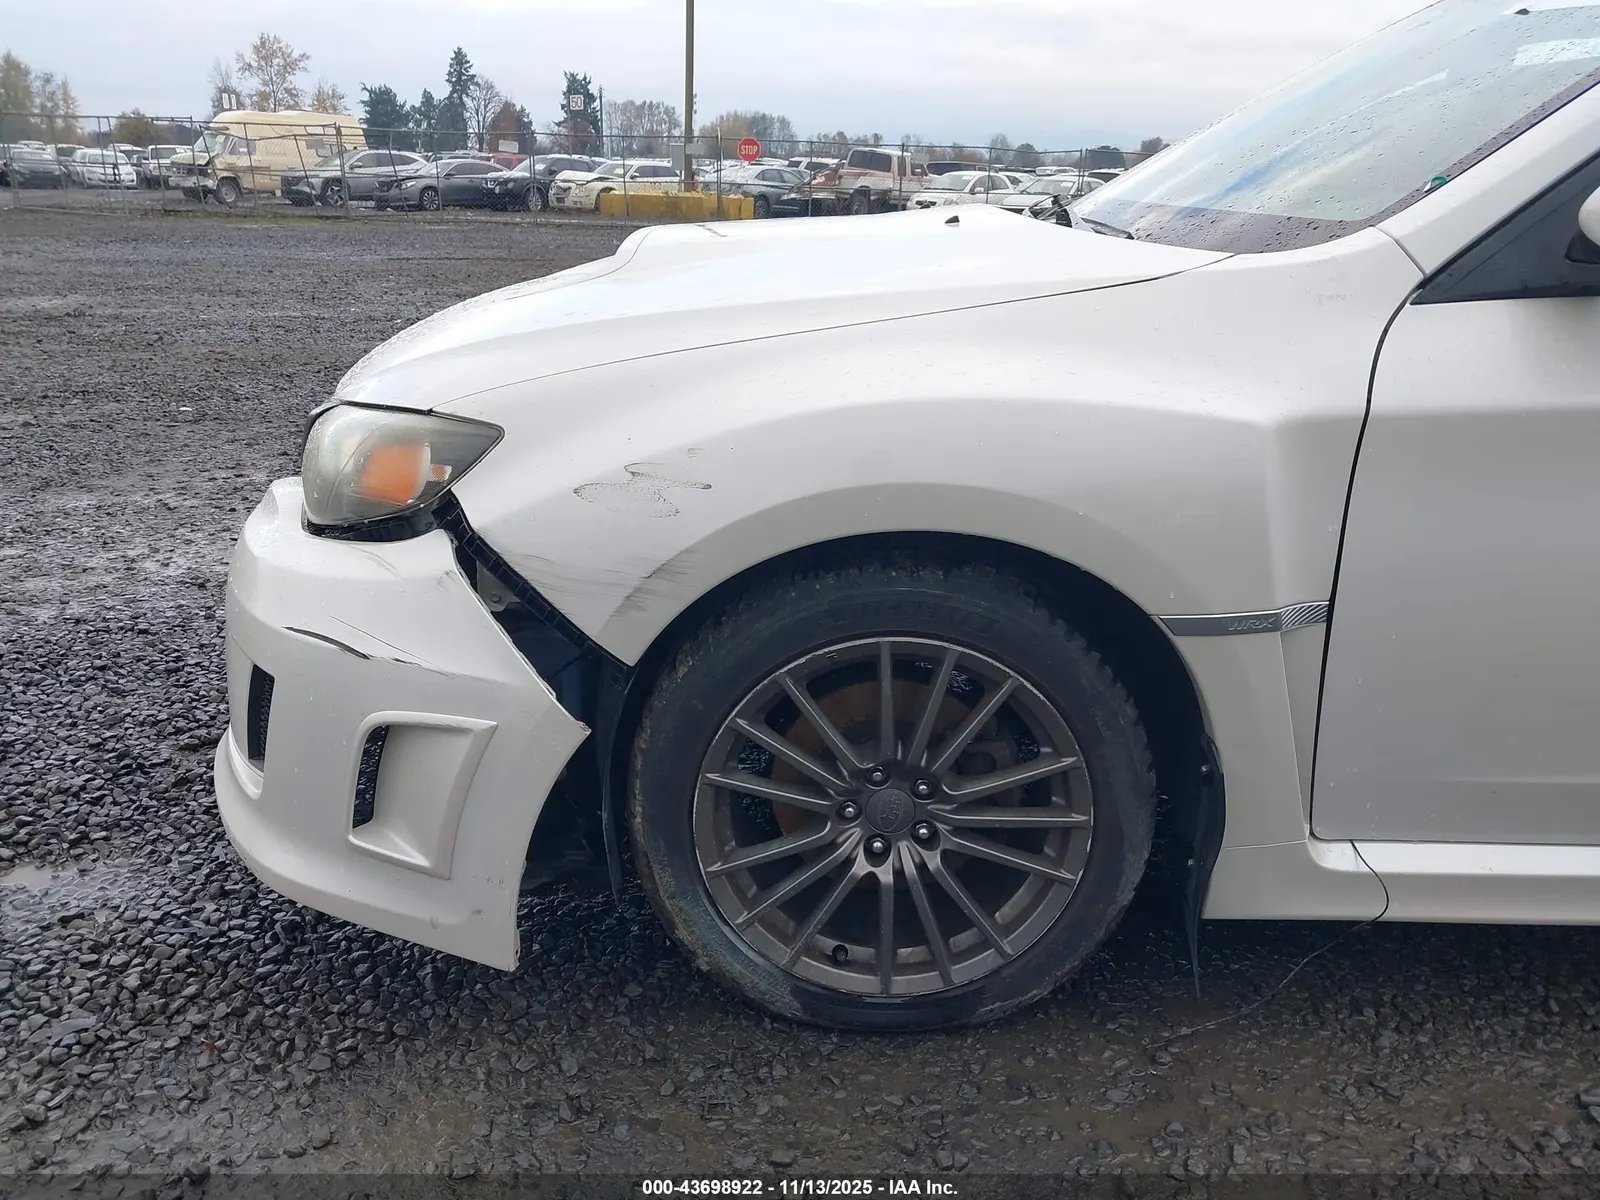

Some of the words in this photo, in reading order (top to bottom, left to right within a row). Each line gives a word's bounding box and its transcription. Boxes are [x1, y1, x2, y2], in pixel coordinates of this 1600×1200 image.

[571, 96, 582, 108] 50
[741, 145, 758, 154] STOP
[1229, 616, 1276, 631] WRX
